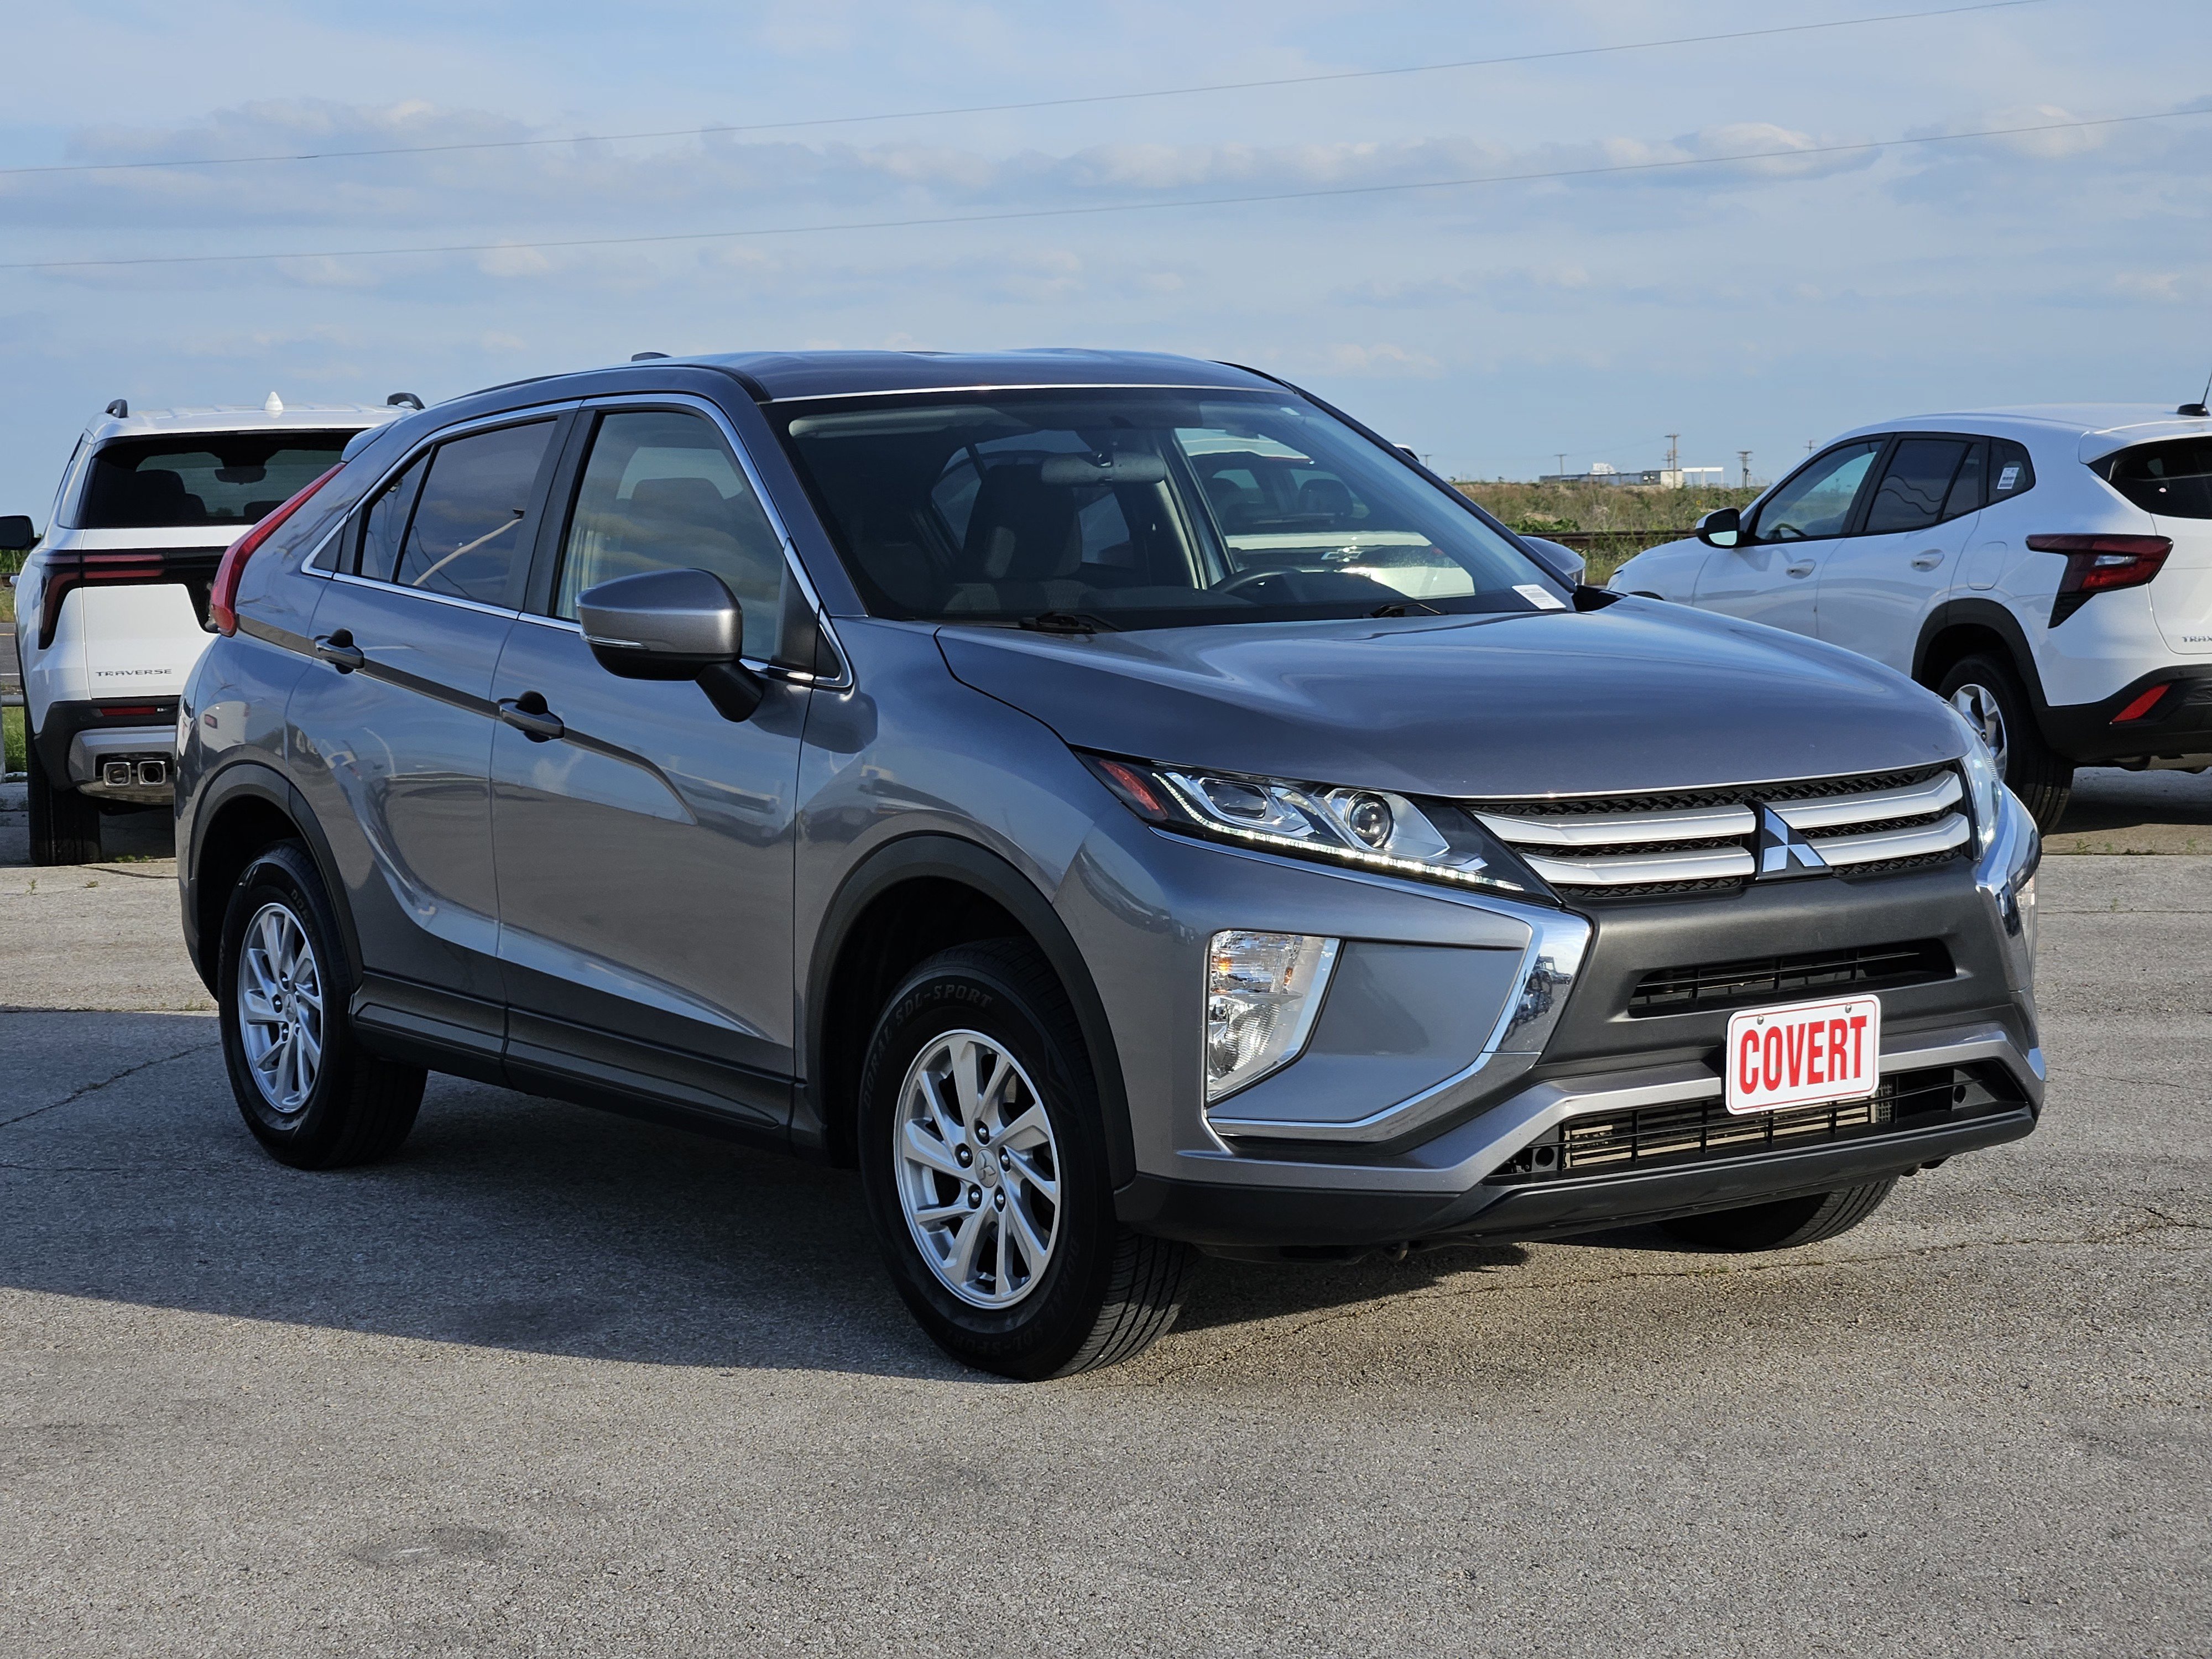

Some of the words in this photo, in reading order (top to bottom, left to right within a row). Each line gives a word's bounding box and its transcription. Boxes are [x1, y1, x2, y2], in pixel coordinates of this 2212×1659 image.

[95, 668, 173, 676] TRAVERSE
[863, 1025, 894, 1109] DORAL
[895, 983, 994, 1025] SDL-SPORT
[1739, 1015, 1867, 1095] COVERT
